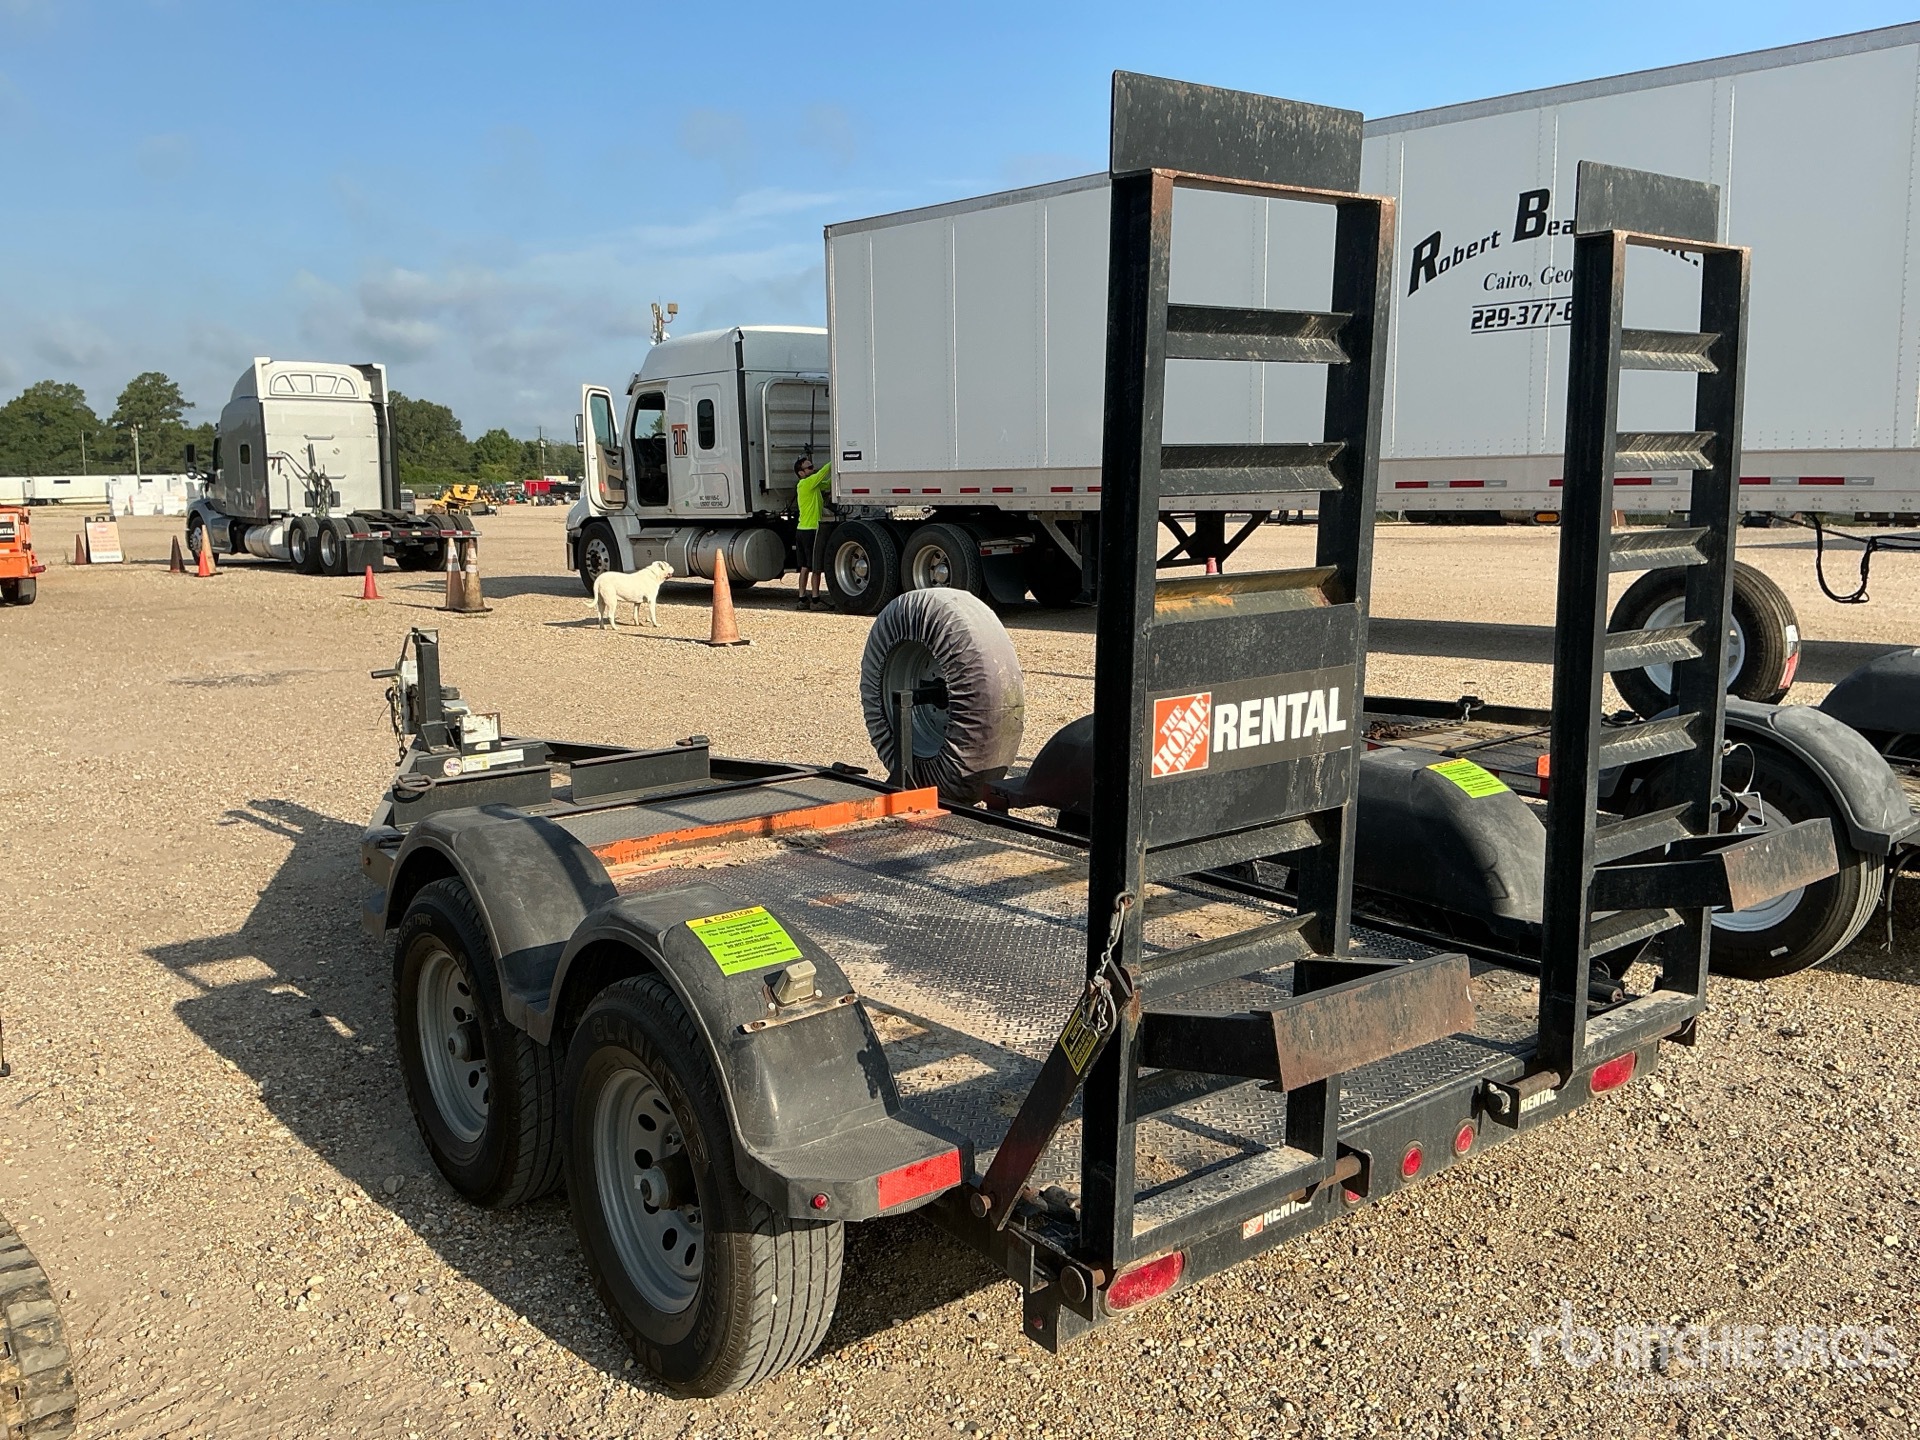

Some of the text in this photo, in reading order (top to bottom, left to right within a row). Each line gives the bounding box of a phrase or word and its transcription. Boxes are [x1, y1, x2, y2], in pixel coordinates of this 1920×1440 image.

[1407, 188, 1575, 297] Robert Bea
[1483, 266, 1572, 291] Cairo, Geo
[1471, 301, 1572, 329] 229-377-6
[1154, 694, 1211, 775] HOME
[1159, 704, 1185, 737] THE
[1213, 687, 1347, 753] RENTAL
[1174, 720, 1211, 772] DEPOT
[714, 909, 754, 921] CAUTION
[1520, 1088, 1557, 1113] RENTAL
